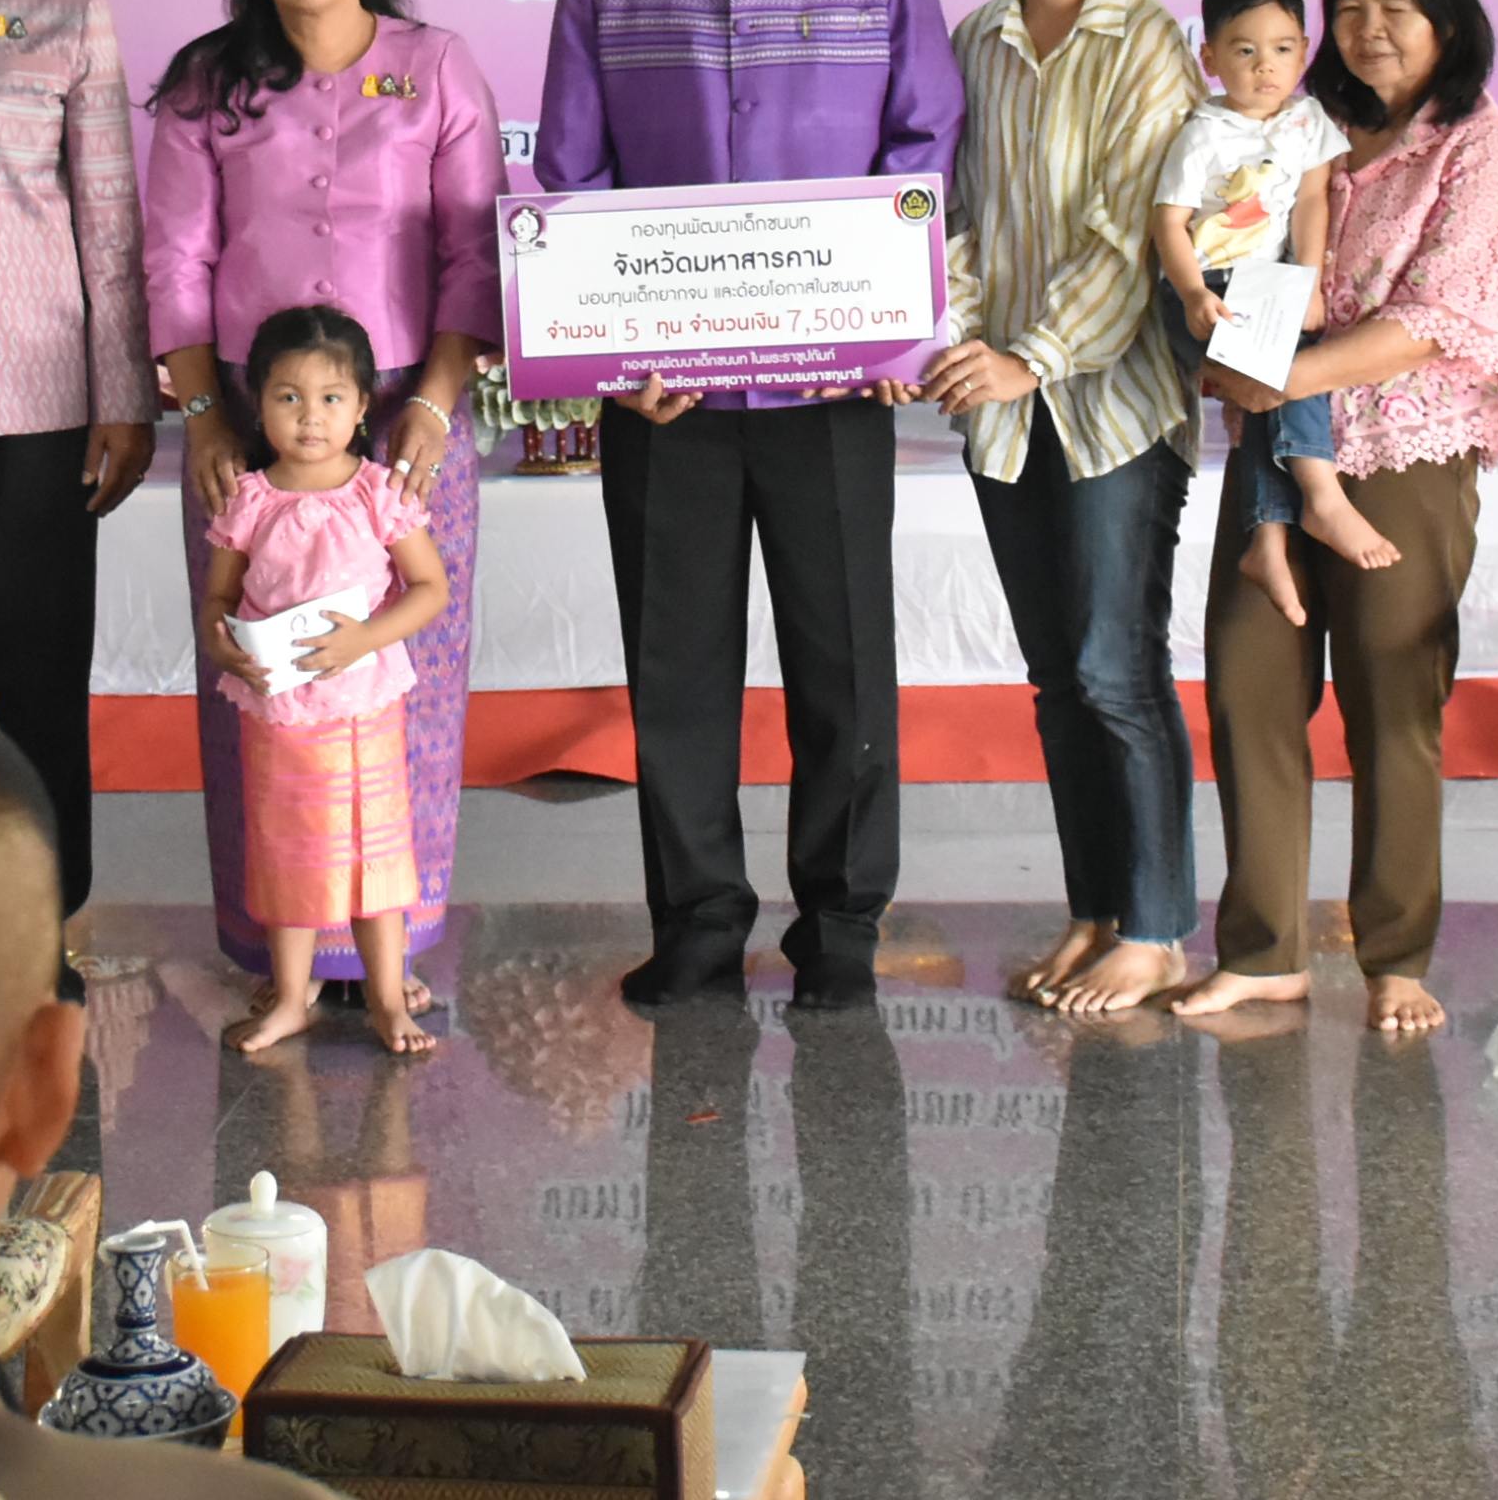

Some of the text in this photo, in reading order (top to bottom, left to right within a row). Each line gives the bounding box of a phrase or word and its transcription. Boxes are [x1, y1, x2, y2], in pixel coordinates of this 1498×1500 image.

[631, 214, 811, 239] กองทุนพัฒนาเด็กชนบท
[614, 249, 832, 276] จังหวัดมหาสารคาม
[578, 278, 871, 307] มอบทุนเด็กยากจน และด้อยโอกาสในชนบท
[547, 307, 907, 342] จำนวน 5 ทุน จำนวนเงิน 7,500 บาท
[622, 352, 748, 371] กองทุนพัฒนาเด็กชนบท
